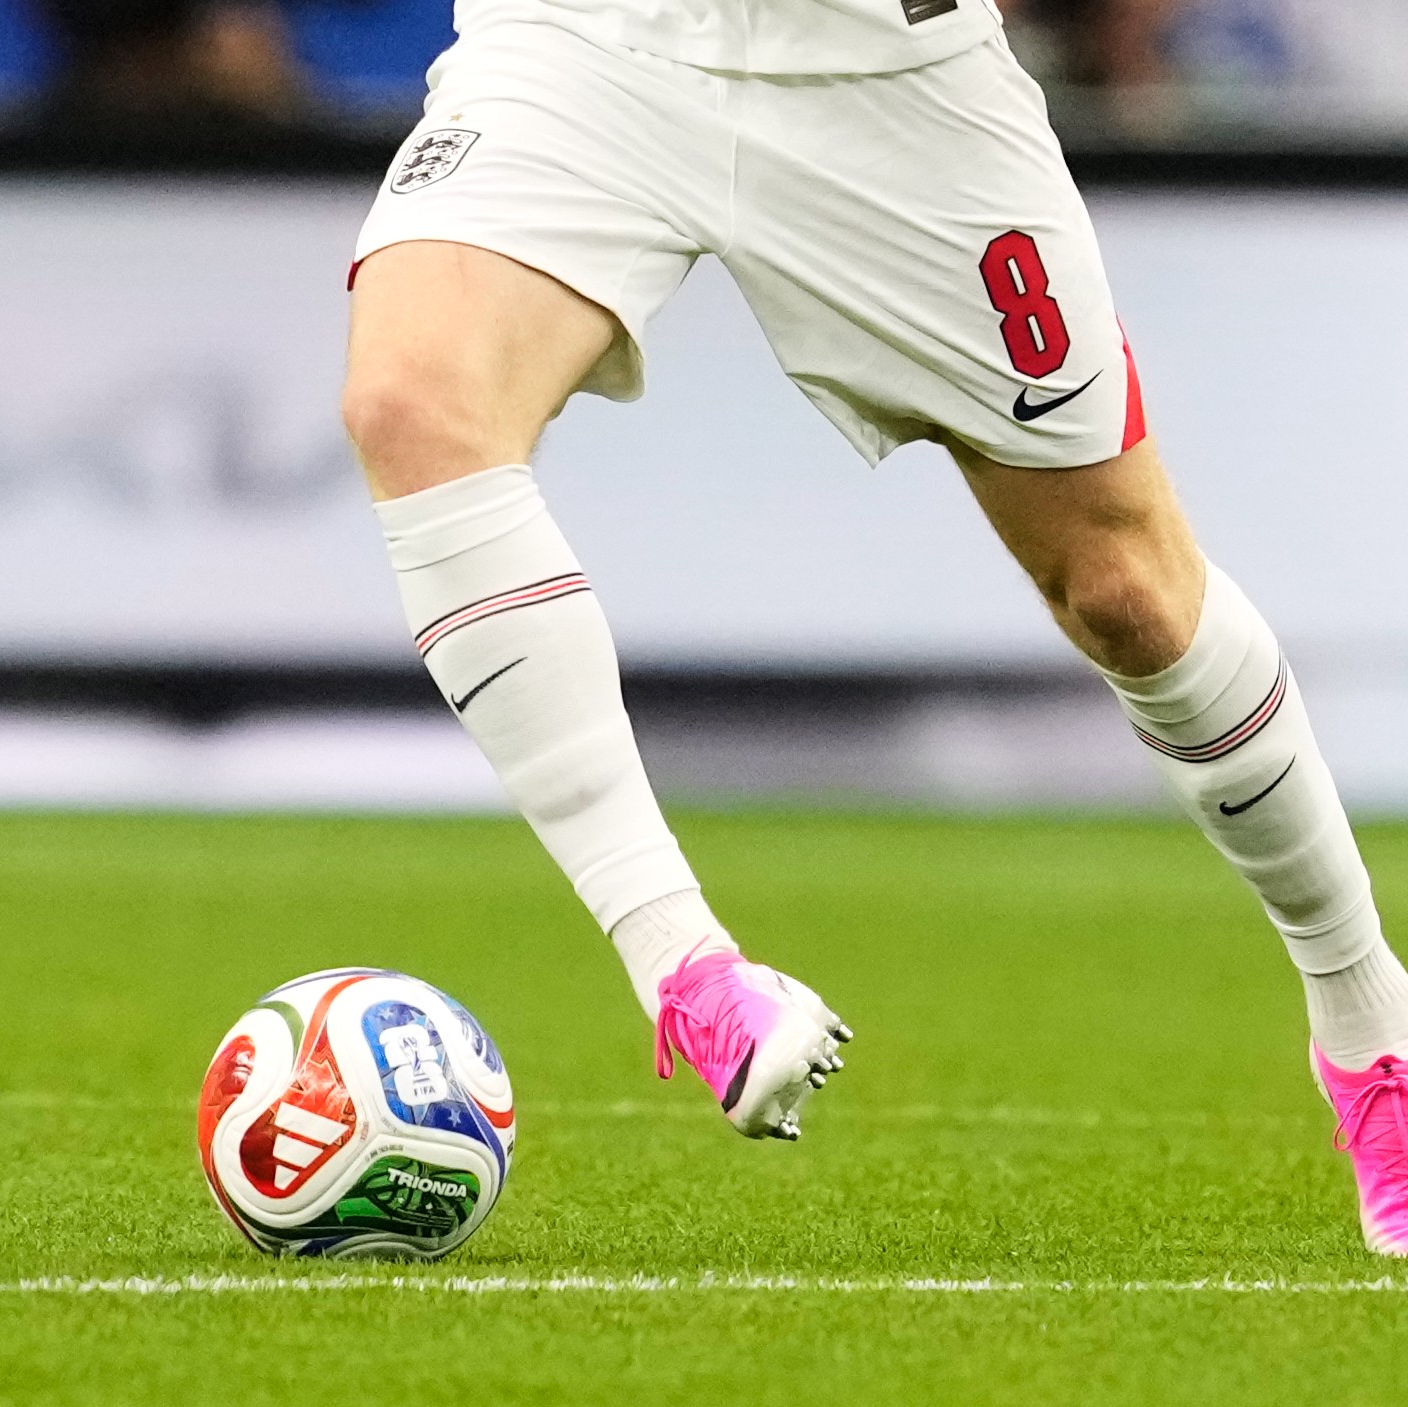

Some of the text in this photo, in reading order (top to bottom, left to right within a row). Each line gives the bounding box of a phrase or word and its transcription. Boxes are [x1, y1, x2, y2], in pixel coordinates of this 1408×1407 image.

[978, 229, 1071, 380] 8
[413, 1086, 437, 1098] FIFA
[387, 1167, 467, 1198] TRIONDA
